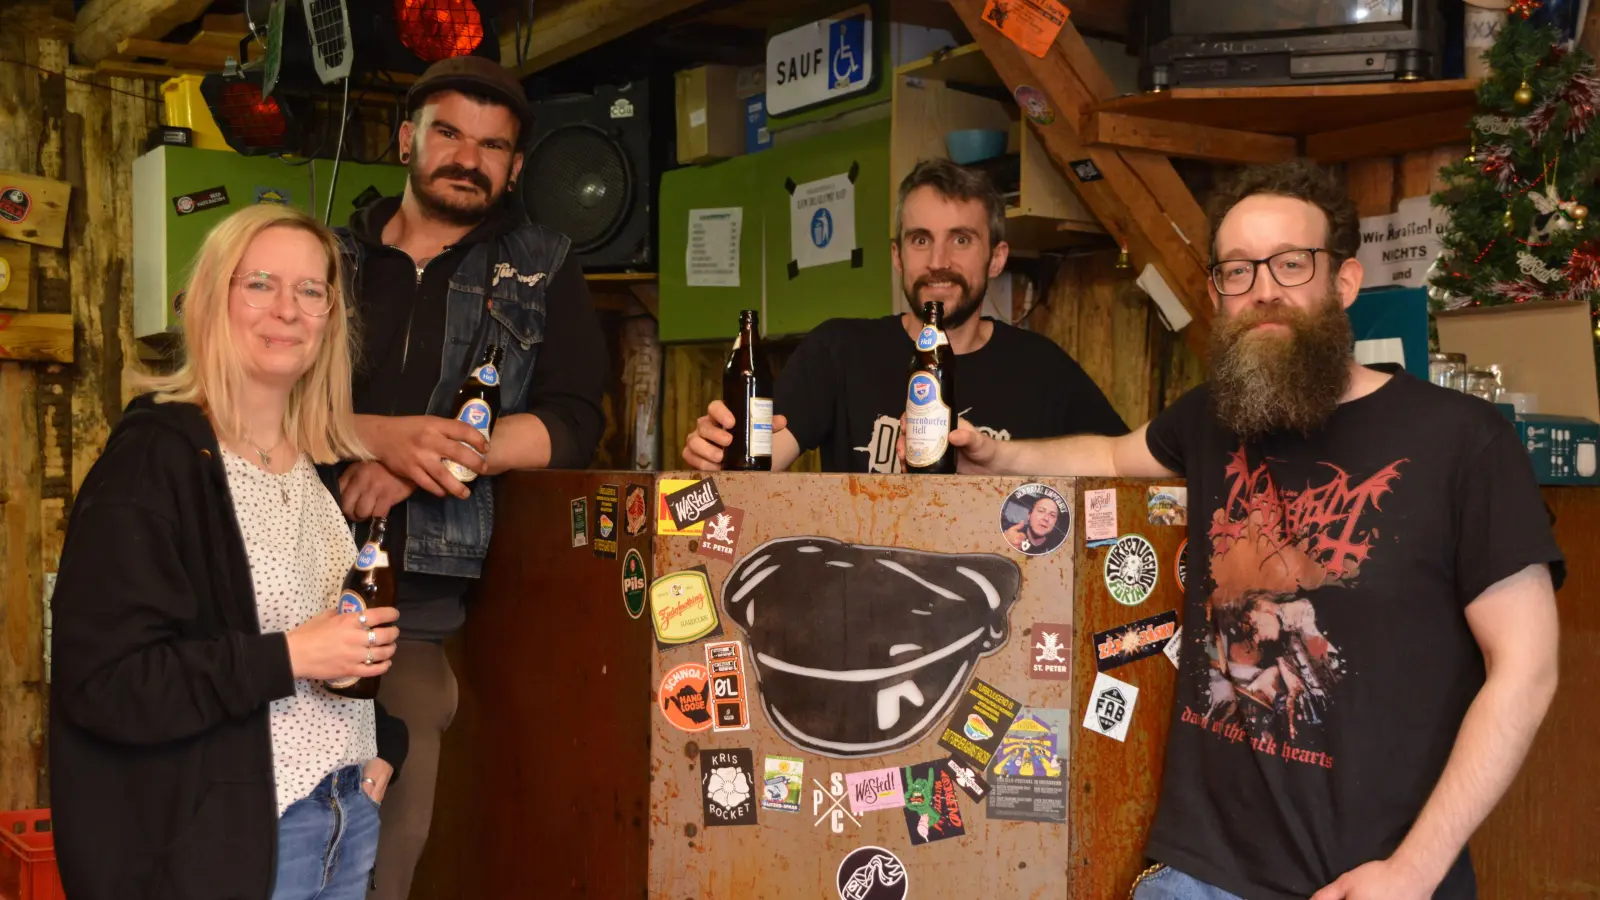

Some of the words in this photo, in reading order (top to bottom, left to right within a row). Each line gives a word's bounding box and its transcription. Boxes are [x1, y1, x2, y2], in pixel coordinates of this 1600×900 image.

[776, 48, 822, 86] SAUF
[1363, 229, 1384, 244] Wir
[1382, 245, 1427, 263] NICHTS
[1392, 268, 1412, 281] und
[912, 425, 927, 436] Hell
[702, 541, 712, 550] ST.
[712, 543, 734, 555] PETER
[624, 577, 645, 592] Pils
[1033, 664, 1043, 672] ST.
[1045, 664, 1067, 673] PETER
[714, 678, 739, 698] ØL
[680, 700, 706, 713] LOOSE
[1095, 698, 1126, 722] FAB
[711, 753, 738, 766] KRIS
[1281, 740, 1334, 769] hearts
[830, 772, 843, 796] S
[813, 789, 823, 816] P
[709, 803, 750, 820] ROCKET
[831, 809, 844, 834] C
